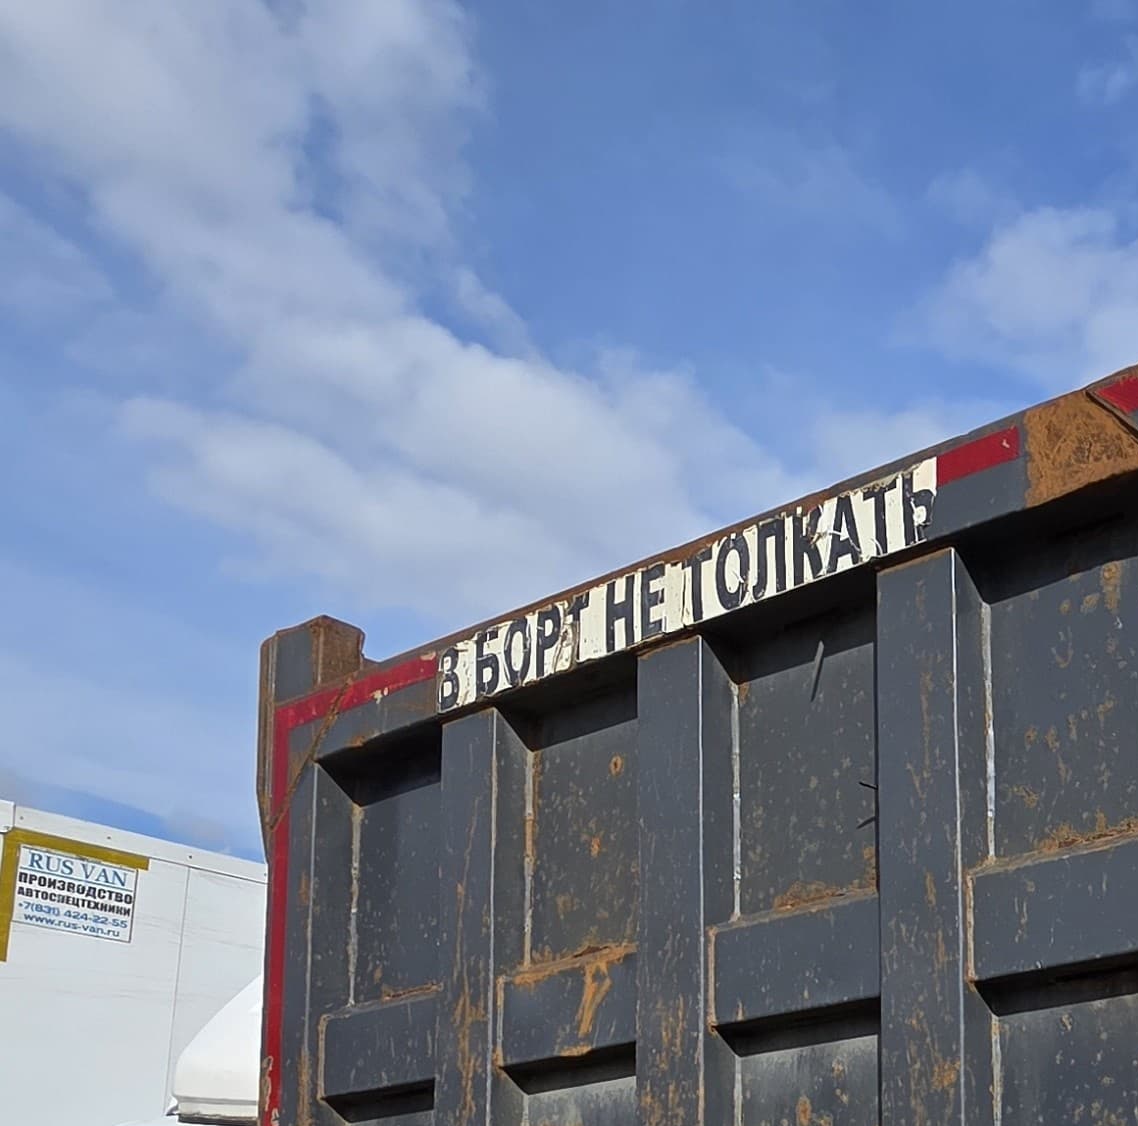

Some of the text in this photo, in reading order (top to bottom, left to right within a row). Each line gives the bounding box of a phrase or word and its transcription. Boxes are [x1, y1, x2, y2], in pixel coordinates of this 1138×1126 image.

[438, 474, 936, 711] В БОРТ НЕ ТОЛКАТЬ
[28, 852, 128, 887] RUS VAN
[17, 887, 131, 917] АВТОСПЕЦТЕХНИКИ
[18, 872, 133, 904] ПРОИЗВОДСТВО
[23, 913, 121, 938] www.rus-van.ru
[63, 909, 129, 929] 424-22-55
